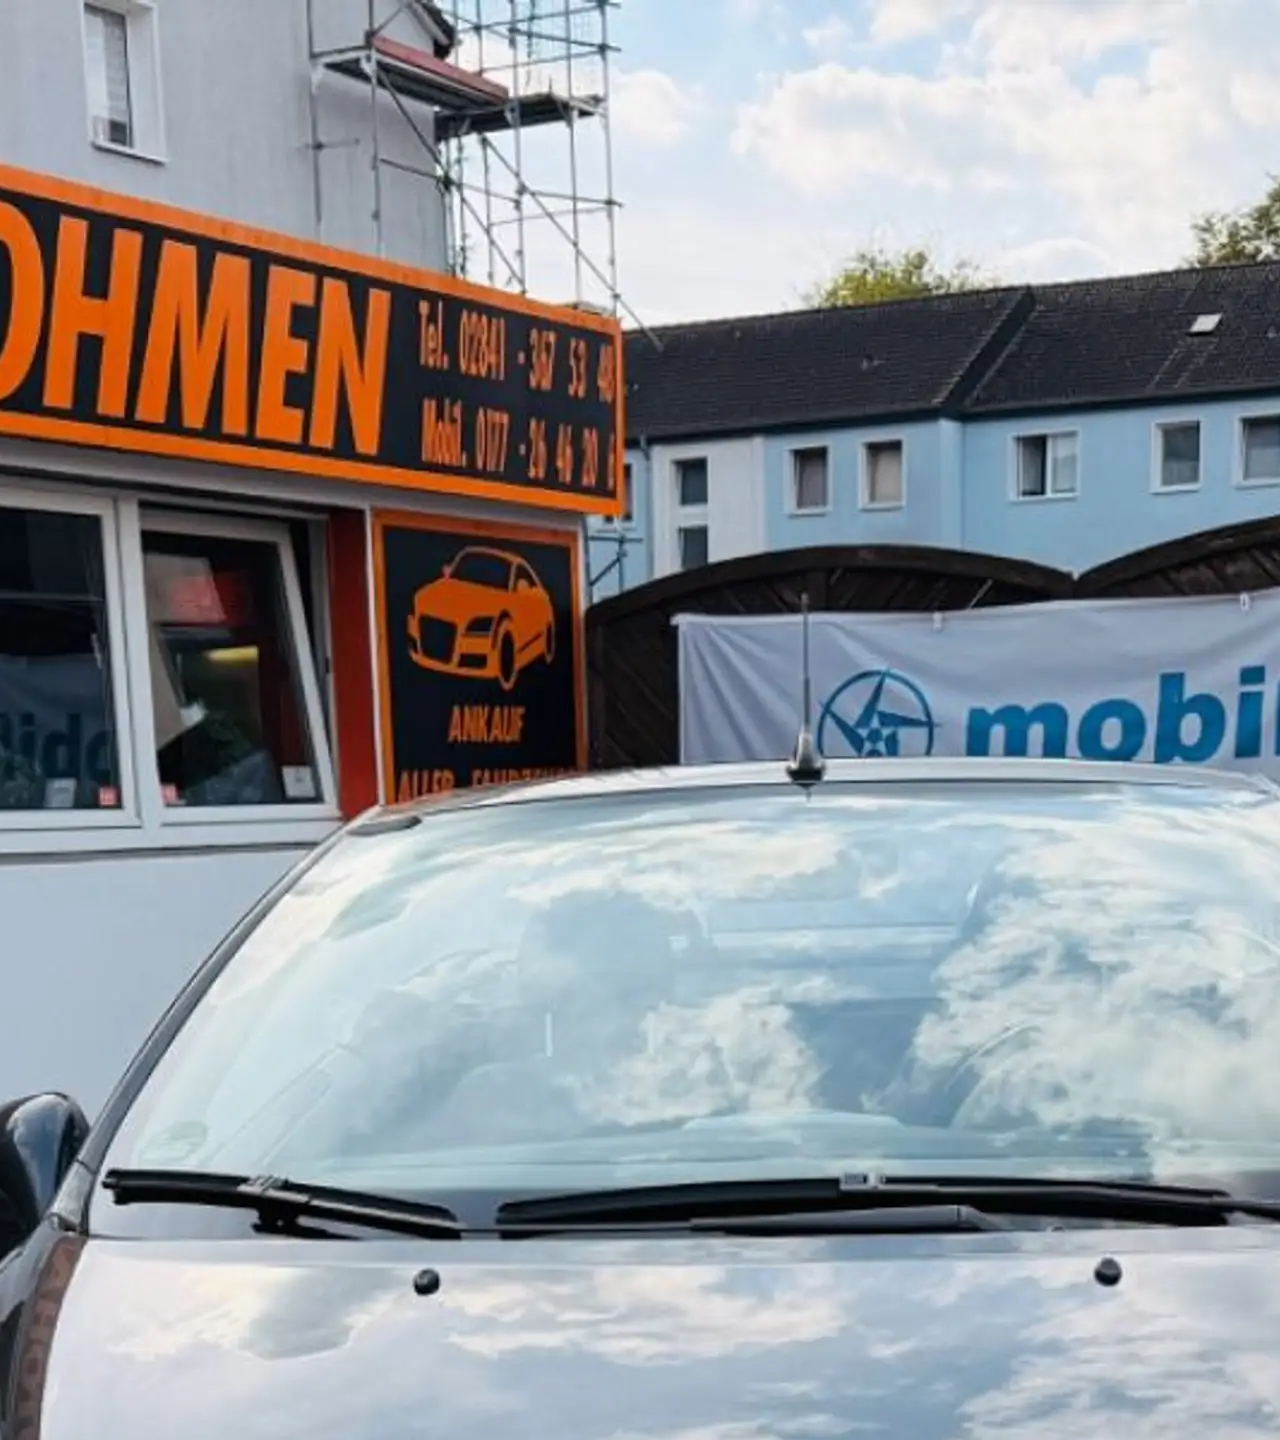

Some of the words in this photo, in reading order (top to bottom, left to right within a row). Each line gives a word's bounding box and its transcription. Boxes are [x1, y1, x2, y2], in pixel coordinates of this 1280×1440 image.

[419, 299, 449, 370] Tel.
[460, 308, 505, 380] 02841
[447, 705, 526, 744] ANKAUF
